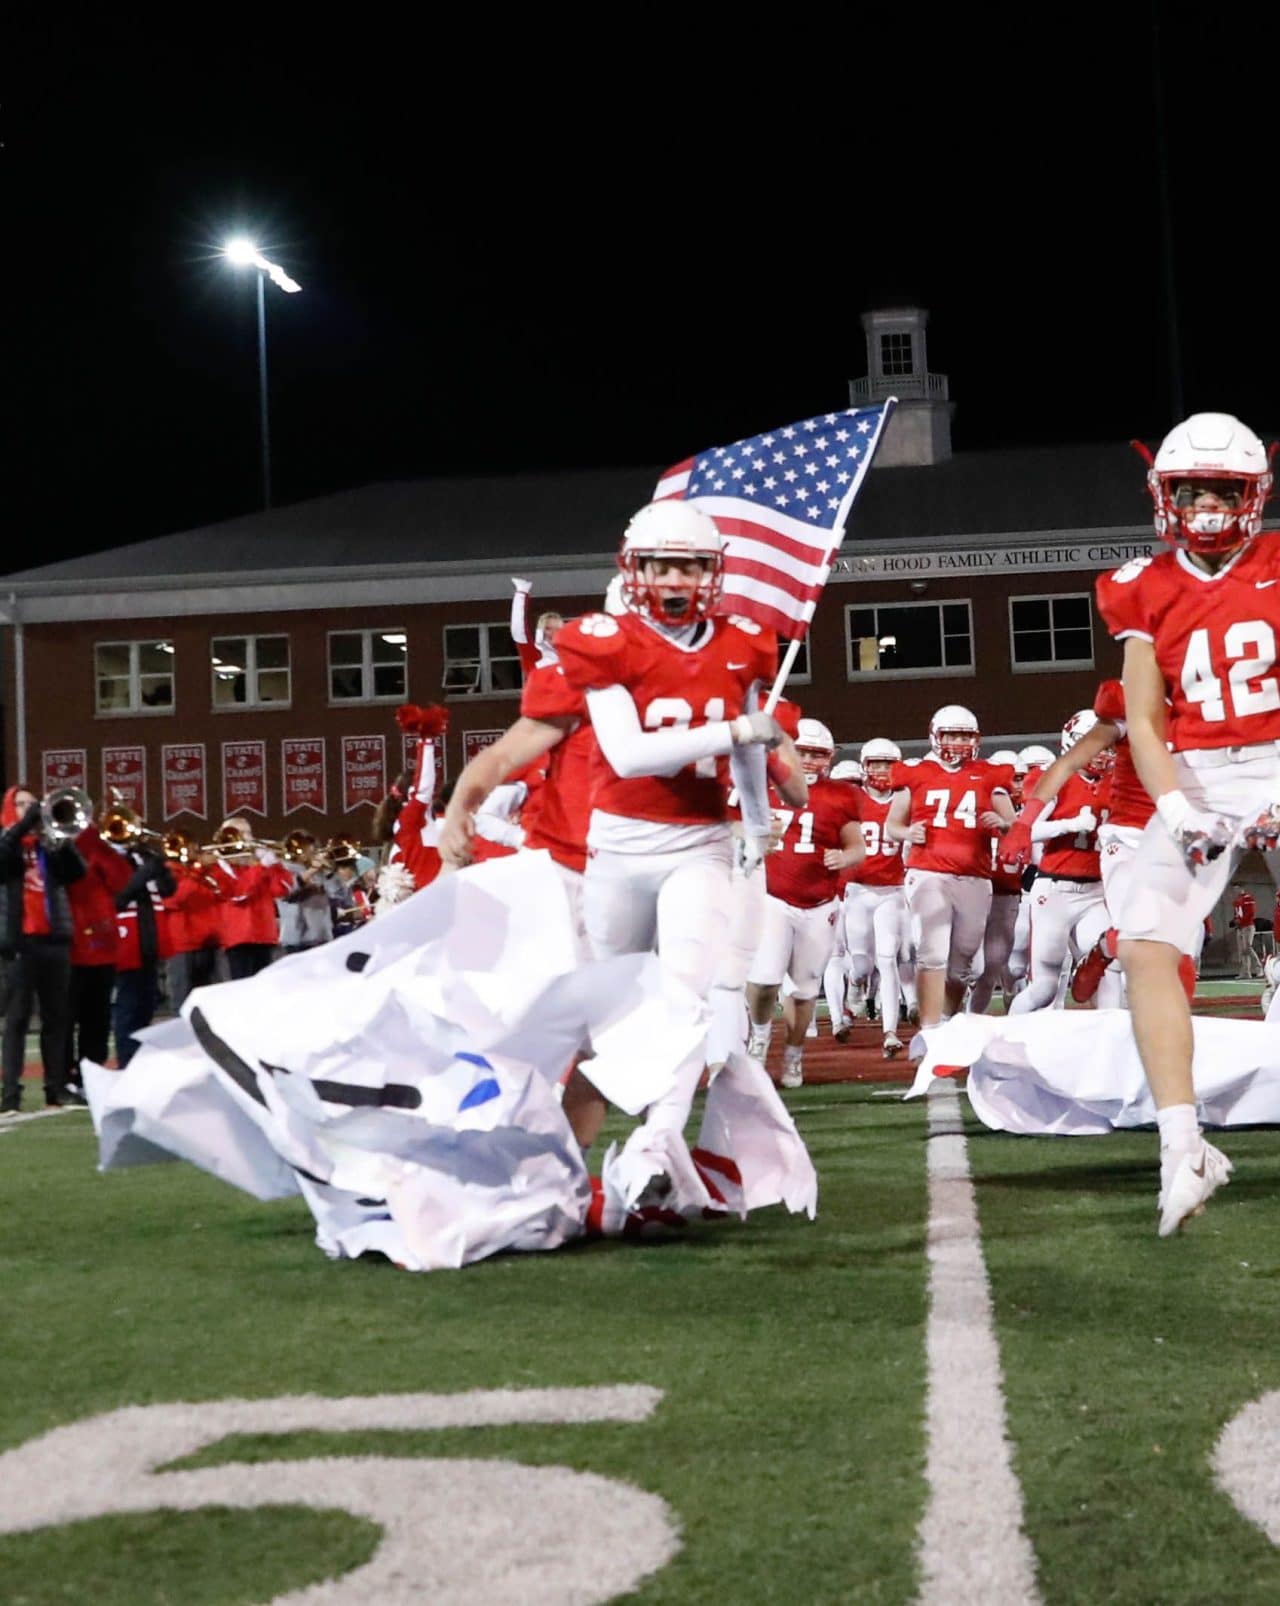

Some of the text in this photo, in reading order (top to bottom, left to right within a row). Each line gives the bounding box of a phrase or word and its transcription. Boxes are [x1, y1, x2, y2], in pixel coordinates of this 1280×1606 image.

[883, 558, 931, 571] HOOD
[938, 552, 997, 568] FAMILY
[1004, 549, 1081, 565] ATHLETIC
[1088, 545, 1153, 560] CENTER
[286, 743, 321, 753] STATE
[346, 740, 381, 751] STATE
[106, 751, 141, 761] STATE
[166, 749, 200, 759] STATE
[226, 746, 261, 756] STATE
[47, 754, 82, 763] STATE
[925, 789, 976, 828] 74
